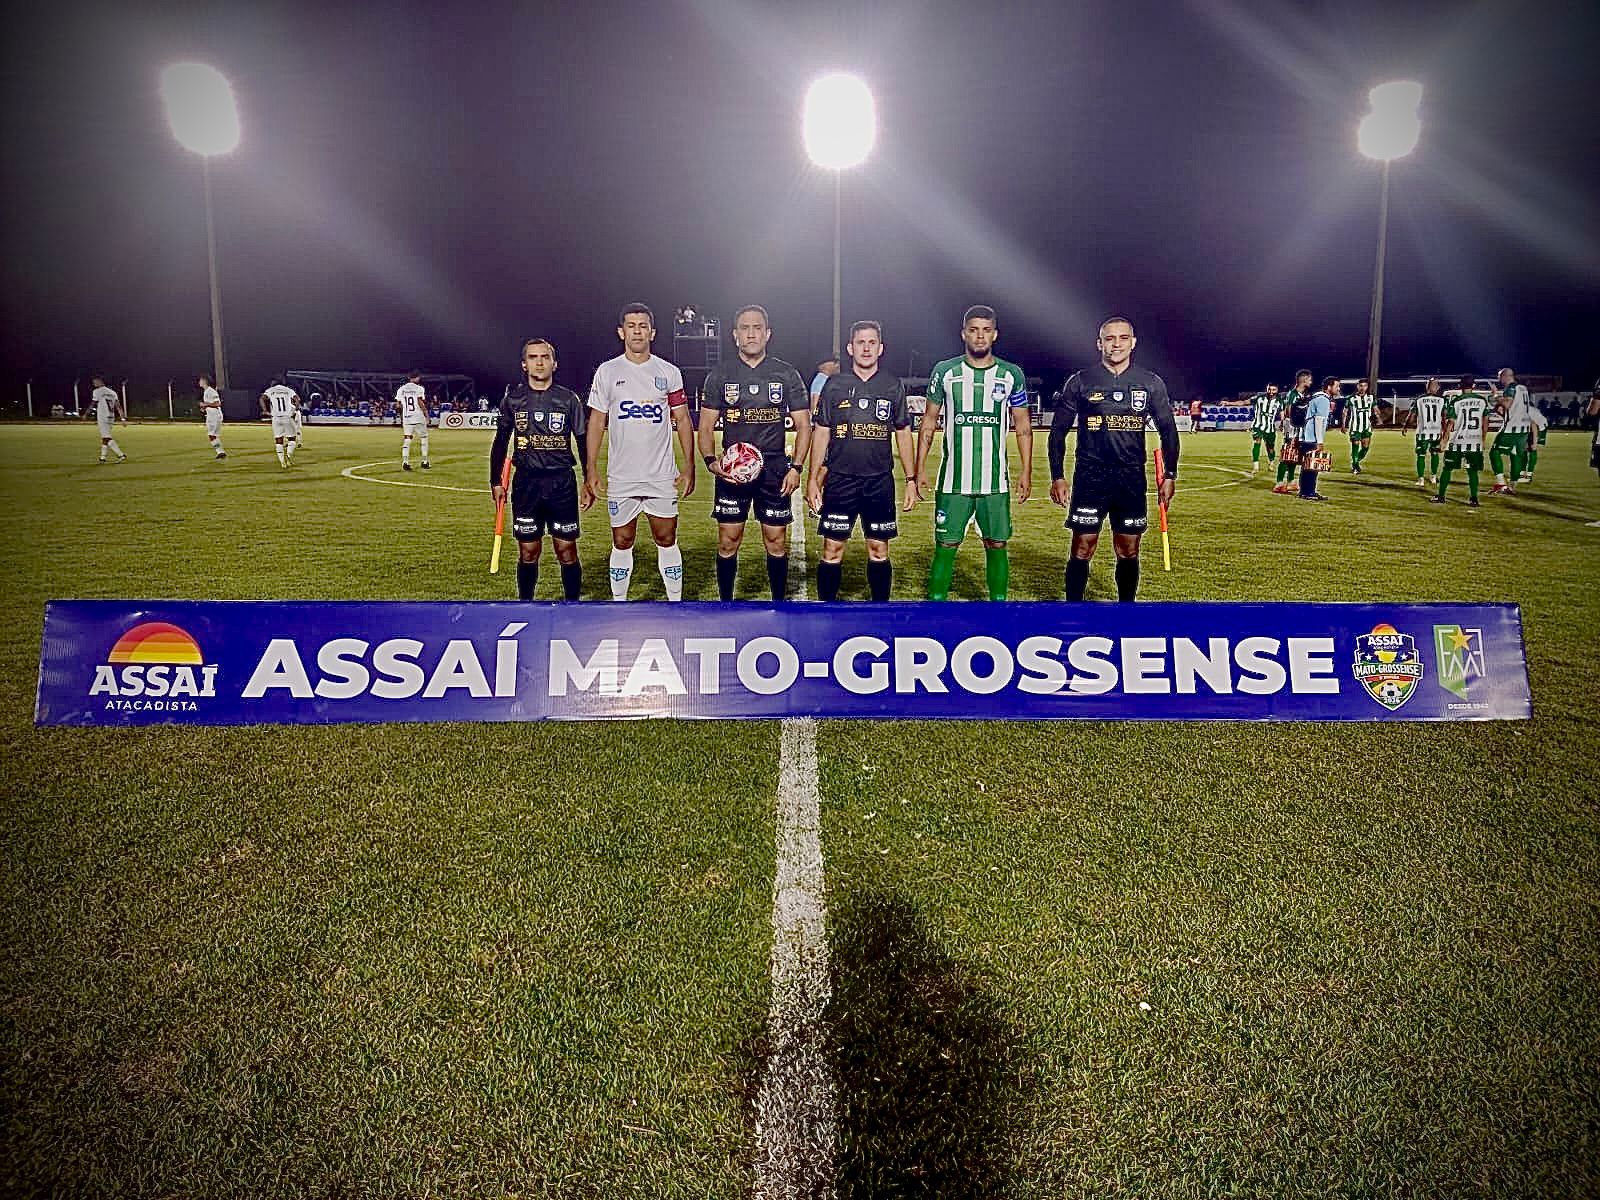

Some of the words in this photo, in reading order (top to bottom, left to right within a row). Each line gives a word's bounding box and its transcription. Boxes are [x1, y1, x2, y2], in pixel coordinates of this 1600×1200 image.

[275, 397, 286, 412] 11
[405, 396, 415, 411] 19
[618, 400, 662, 423] Seeg
[1425, 404, 1437, 422] 11
[1462, 408, 1480, 430] 15
[469, 416, 498, 426] CRE
[966, 415, 1000, 424] CRESOL
[241, 622, 529, 699] ASSAÍ
[548, 635, 1341, 696] MATO-GROSSENSE
[1355, 663, 1421, 677] MATO-GROSSENSE
[88, 664, 219, 697] ASSAÍ
[105, 700, 198, 711] ATACADISTA
